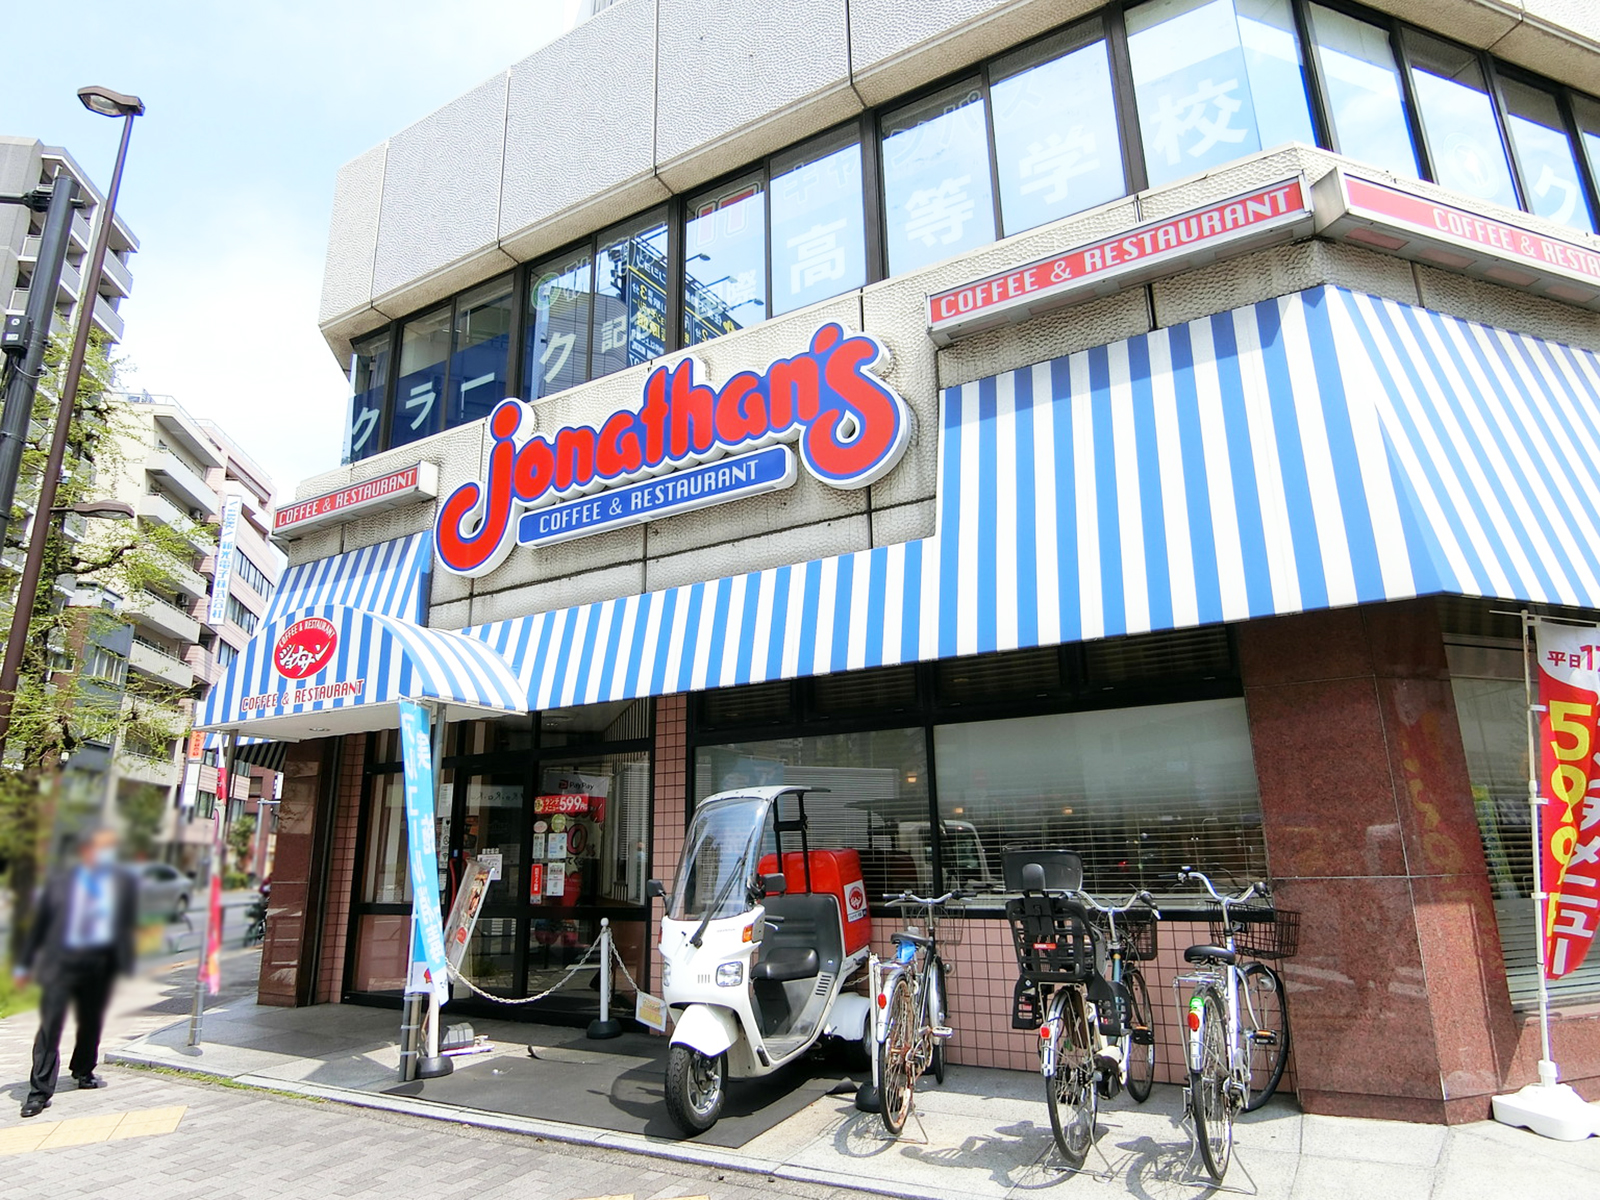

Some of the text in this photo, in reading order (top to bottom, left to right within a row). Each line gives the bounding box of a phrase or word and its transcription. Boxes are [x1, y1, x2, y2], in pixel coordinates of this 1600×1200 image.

[940, 187, 1290, 318] COFFEE & RESTAURANT
[1432, 207, 1515, 251] COFFEE
[1520, 235, 1537, 257] &
[279, 470, 415, 525] COFFEE & RESTAURANT
[539, 459, 759, 533] COFFEE & RESTAURANT
[279, 623, 298, 648] COFFEE
[304, 619, 336, 639] RESTAURANT
[1547, 645, 1600, 673] 平日1
[241, 679, 364, 711] COFFEE & RESTAURANT
[569, 781, 595, 791] PayPay
